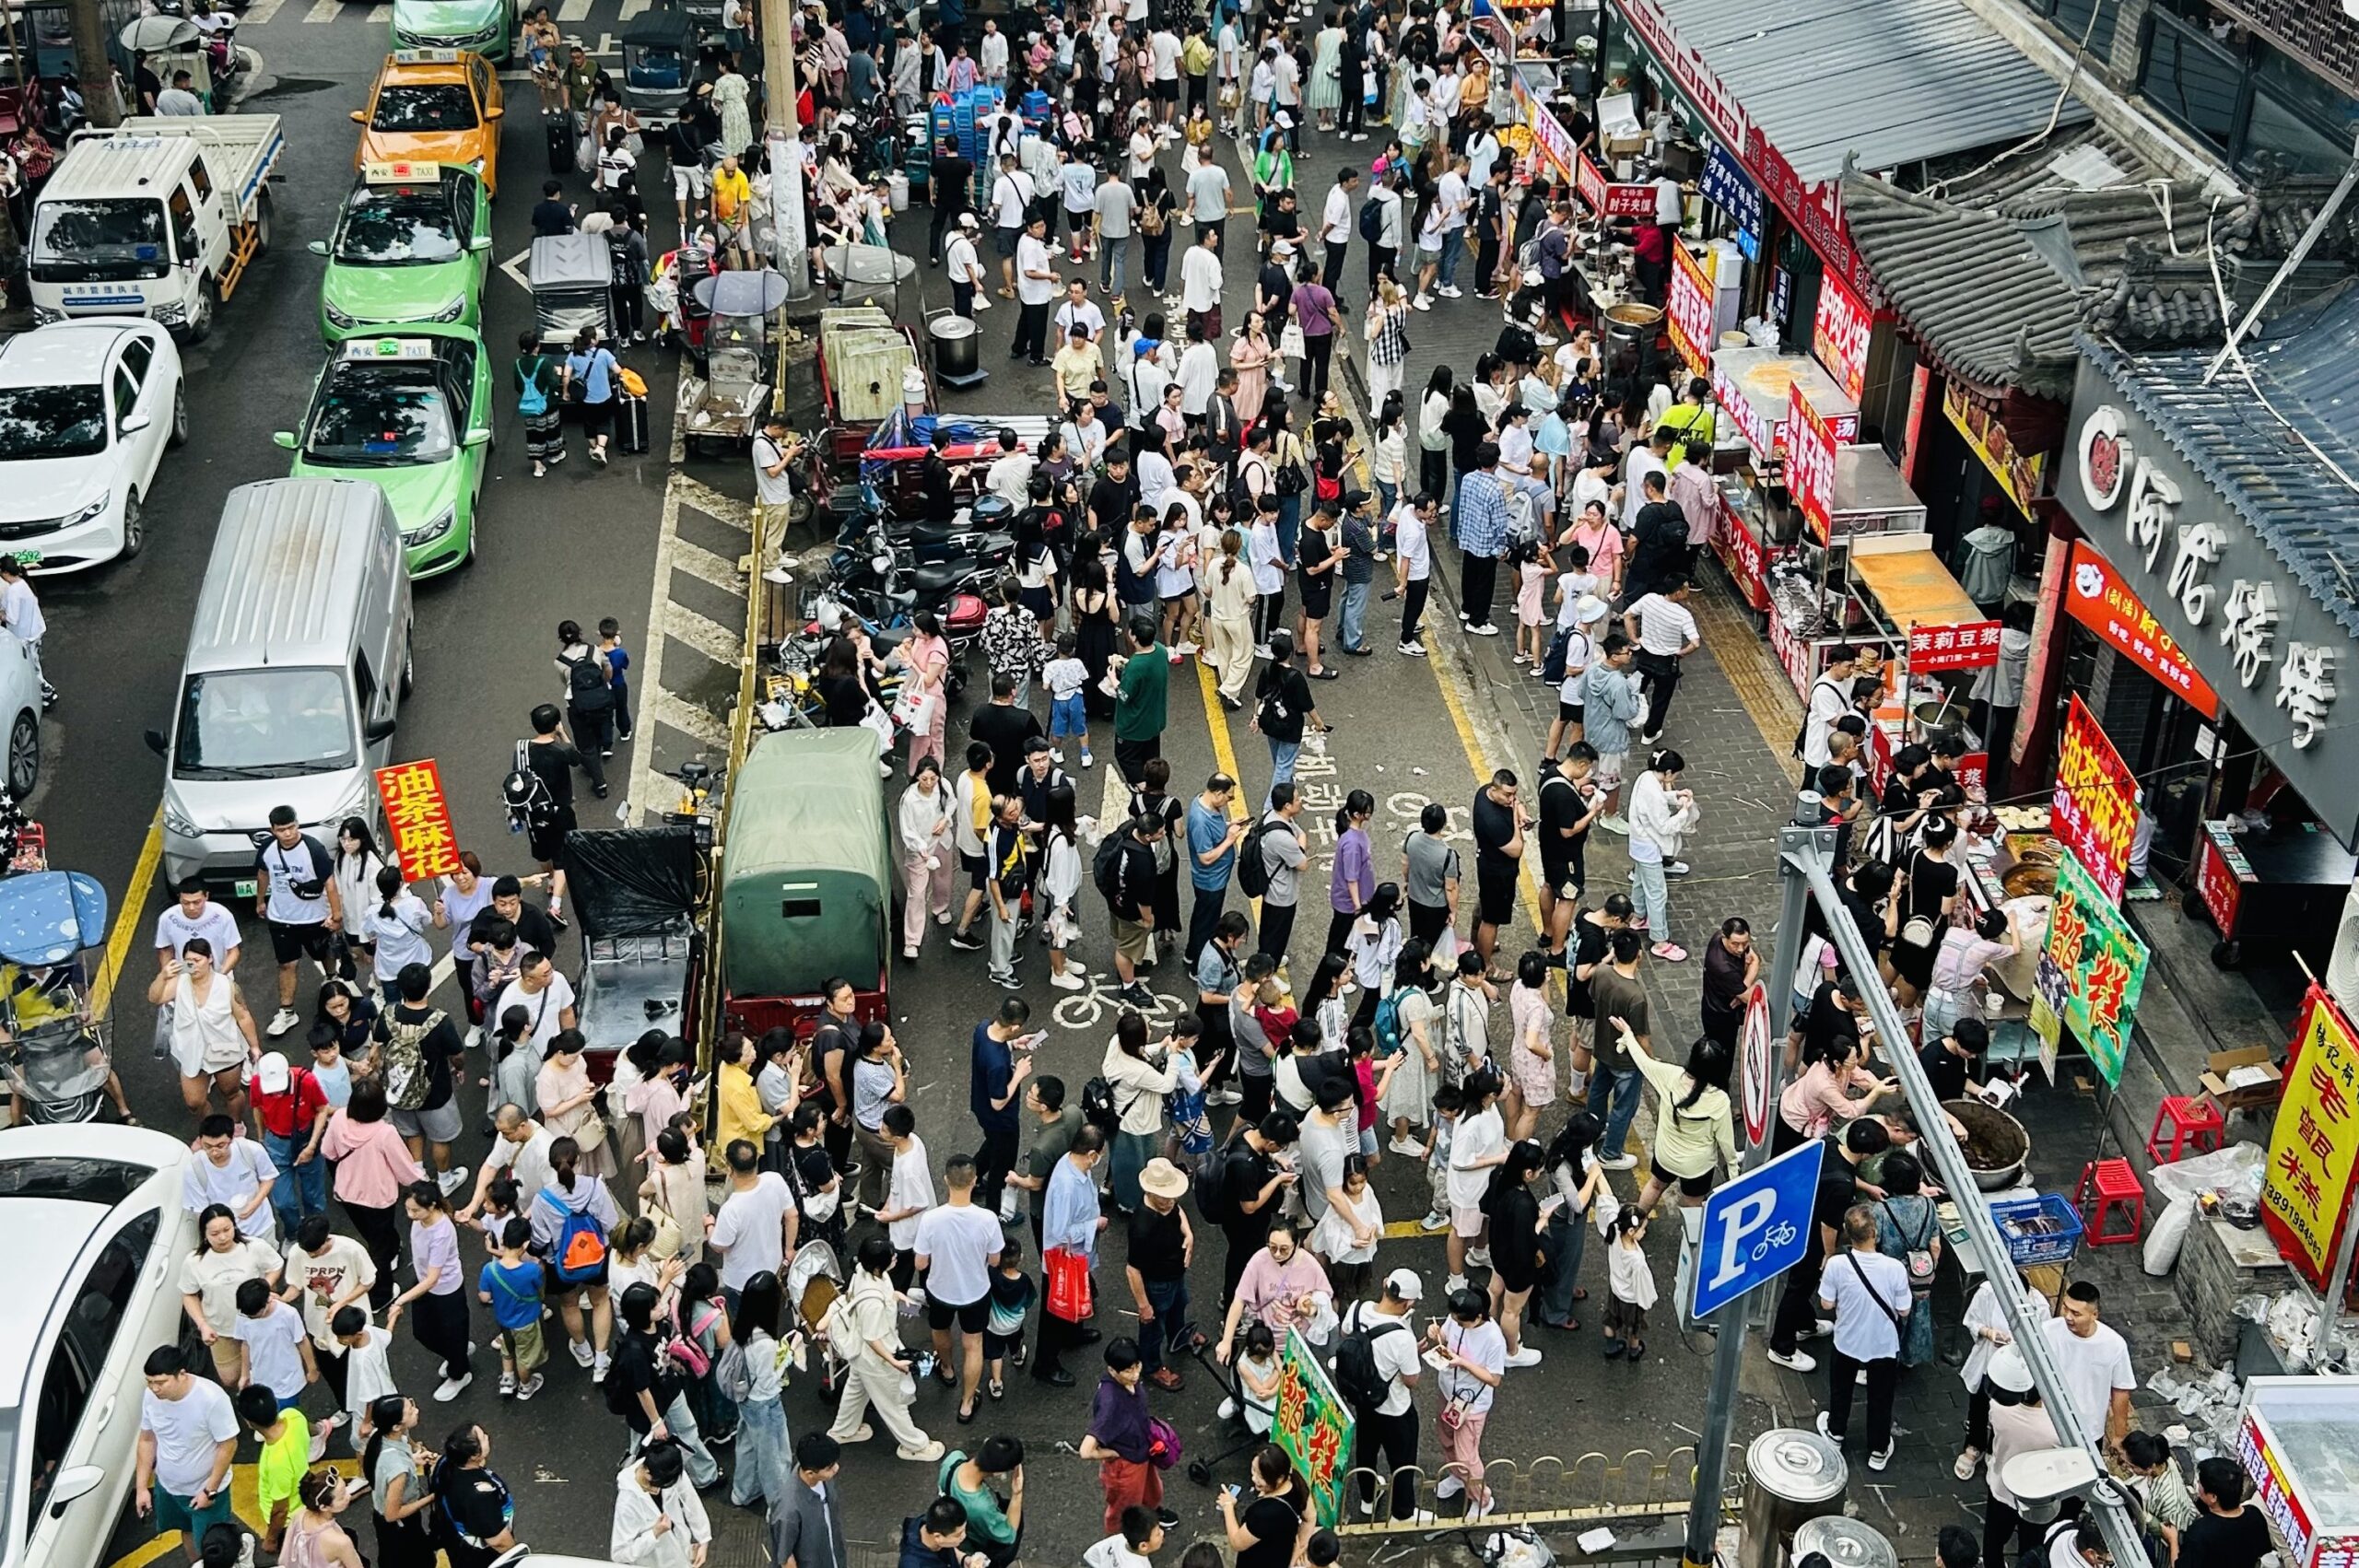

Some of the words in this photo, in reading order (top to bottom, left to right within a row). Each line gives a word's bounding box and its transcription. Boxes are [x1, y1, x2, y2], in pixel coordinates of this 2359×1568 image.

[438, 53, 454, 61] TAXI
[416, 168, 434, 176] TAXI
[1609, 198, 1650, 213] 肘子夹馍
[63, 285, 141, 295] 城市管理执法
[1670, 258, 1711, 358] 茉莉豆浆
[405, 346, 426, 357] TAXI
[1818, 274, 1871, 378] 驴肉火烧
[1911, 627, 1999, 651] 茉莉豆浆
[2108, 619, 2129, 643] 好吃
[2133, 638, 2154, 661] 好吃
[2159, 657, 2190, 689] 真好吃
[381, 766, 460, 878] 油茶麻花
[2059, 720, 2135, 872] 油茶麻花
[2053, 779, 2122, 902] 30年老味道
[1708, 1187, 1778, 1292] P
